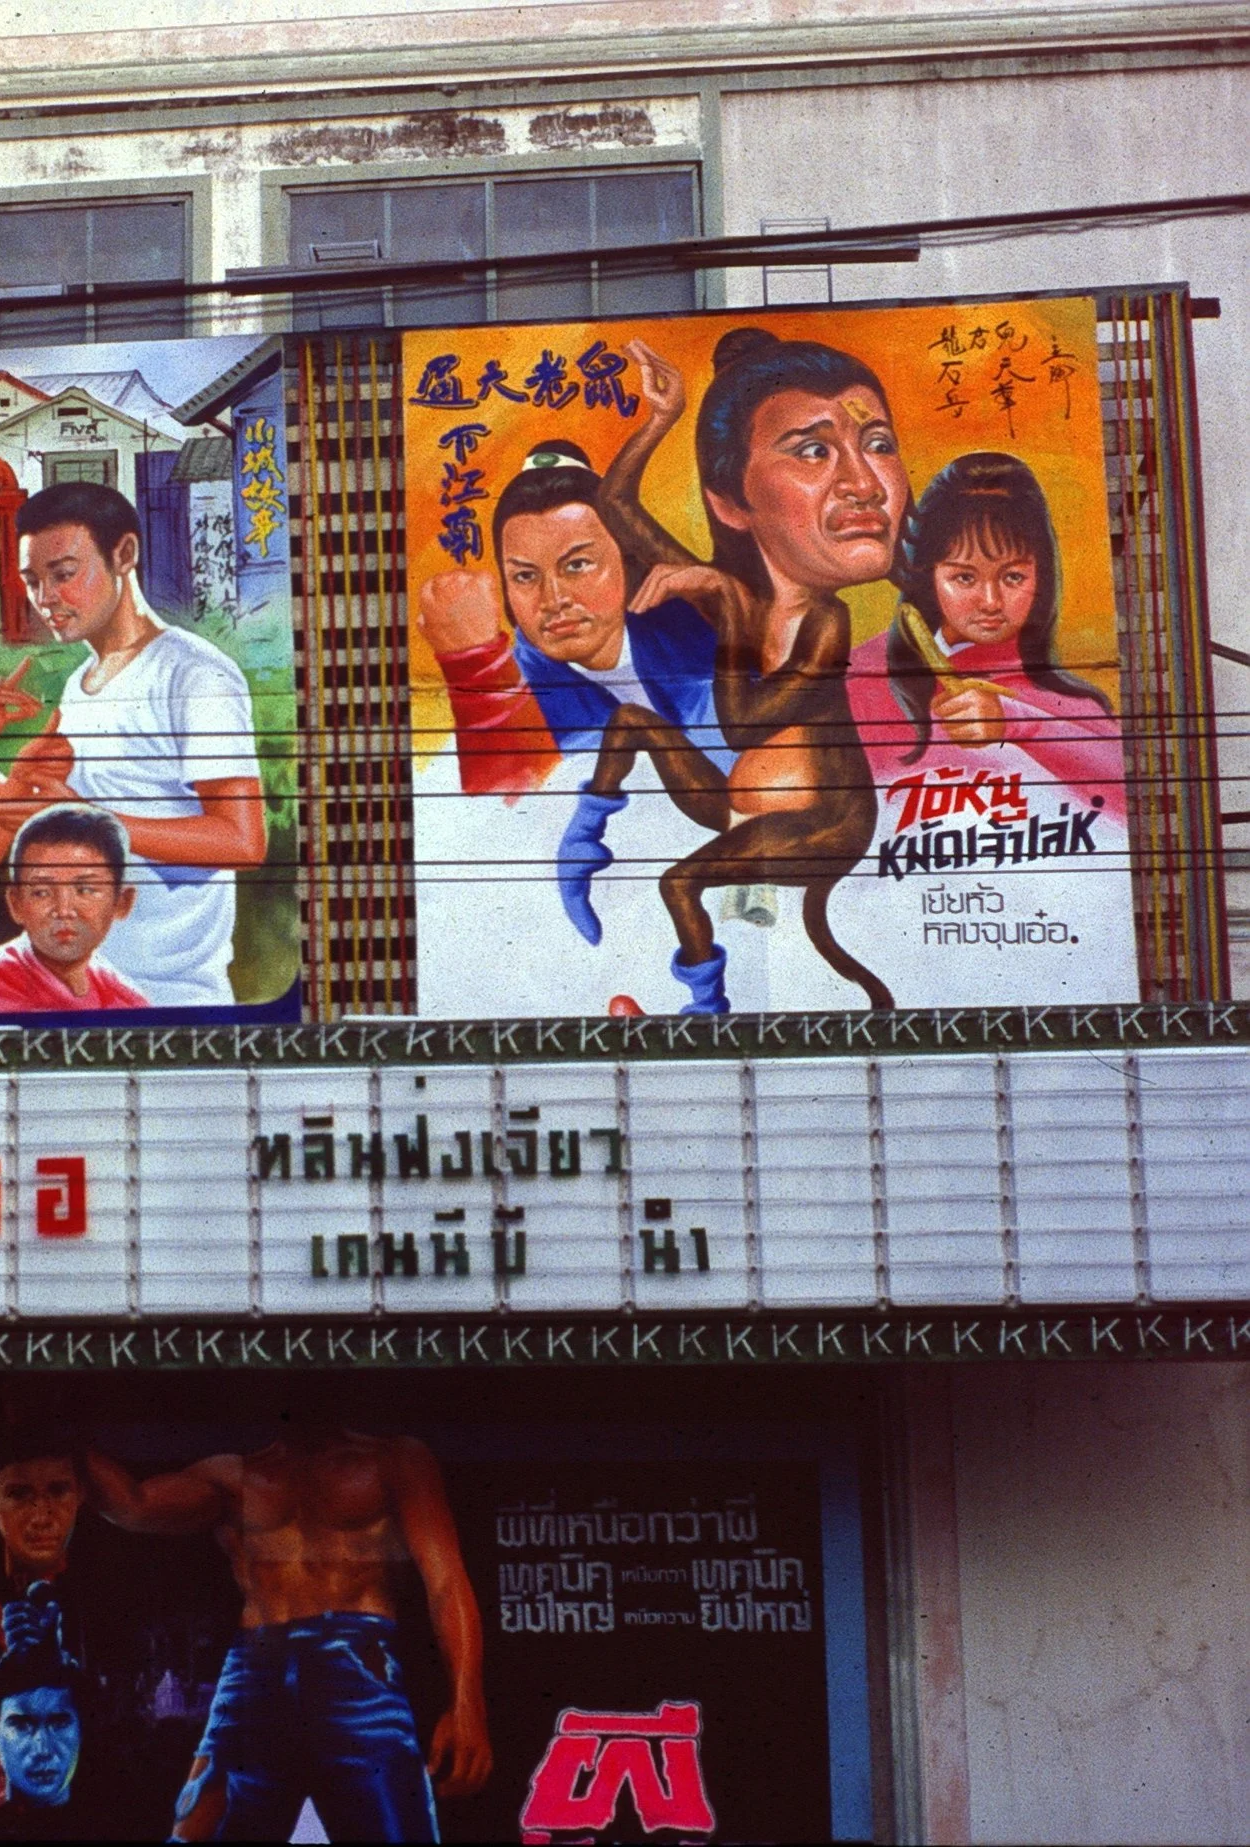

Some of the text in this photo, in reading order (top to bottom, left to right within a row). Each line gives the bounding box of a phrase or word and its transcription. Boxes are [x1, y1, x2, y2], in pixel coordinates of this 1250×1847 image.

[241, 417, 285, 559] 小城故事
[438, 422, 491, 566] 下江南
[519, 1699, 718, 1834] ผี
